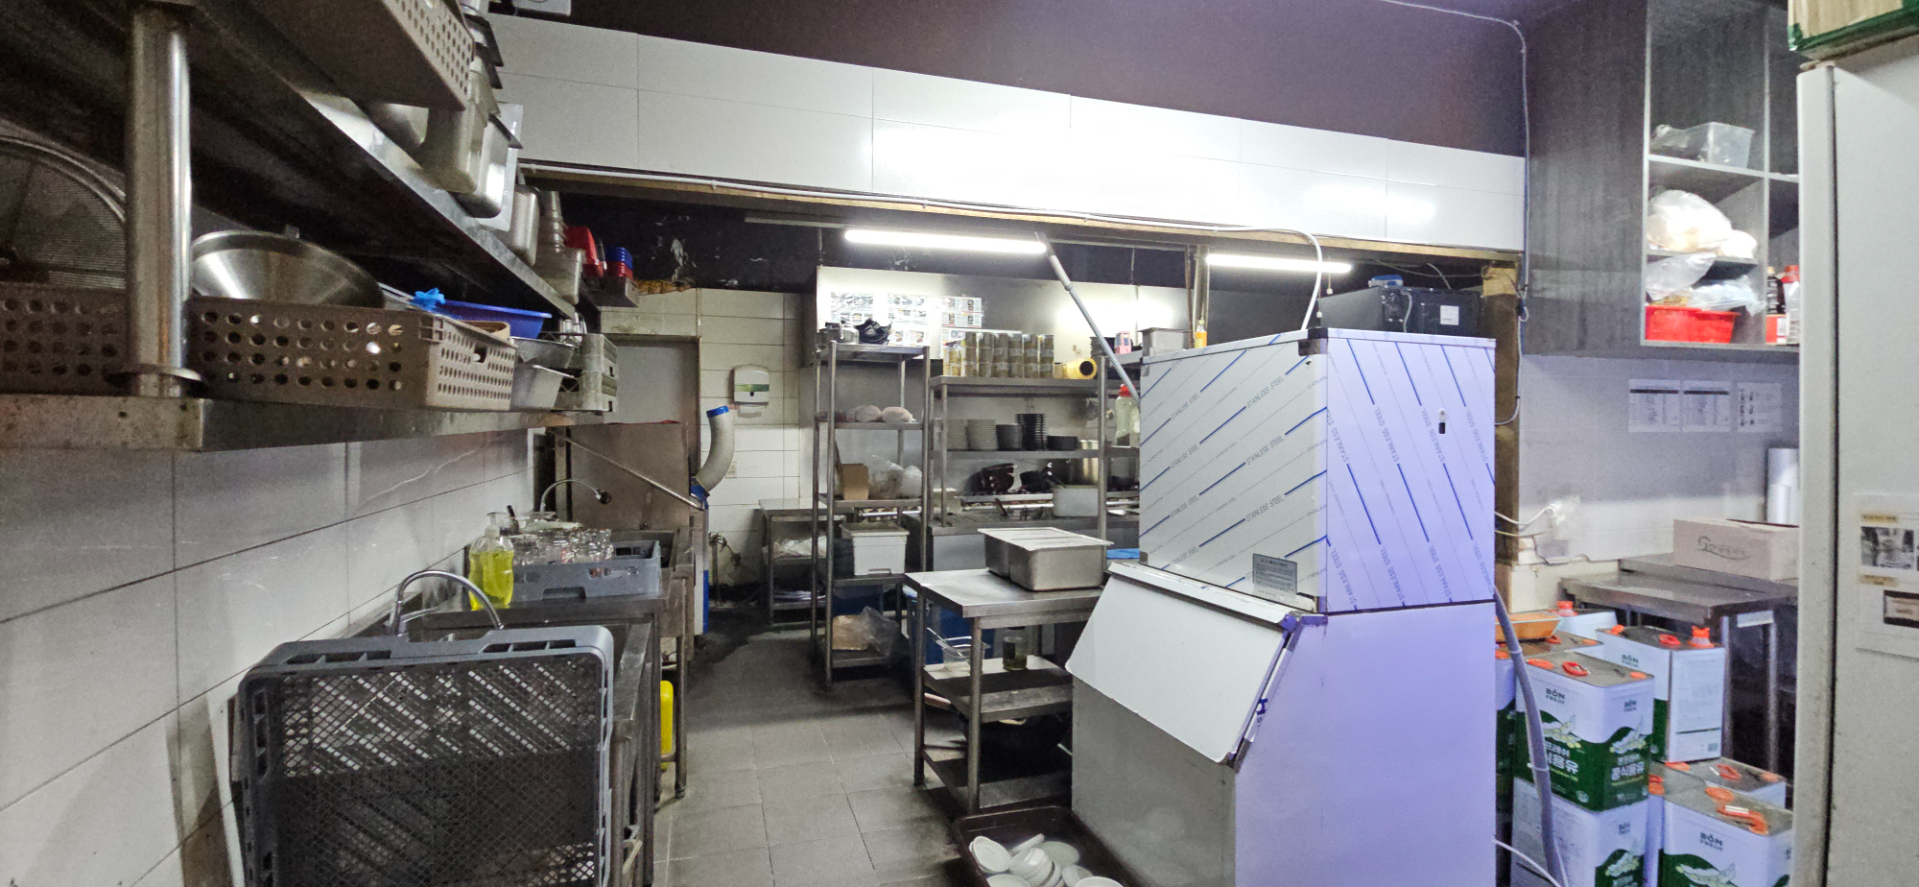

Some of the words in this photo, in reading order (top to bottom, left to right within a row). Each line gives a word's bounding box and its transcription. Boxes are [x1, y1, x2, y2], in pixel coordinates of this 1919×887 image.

[1247, 386, 1269, 409] STAINLESS
[1270, 375, 1284, 390] STEEL
[1374, 406, 1385, 427] STEEL
[1246, 444, 1269, 465] STAINLESS
[1270, 435, 1284, 449] STEEL
[1382, 428, 1400, 463] STAINLESS
[1246, 503, 1269, 522] STAINLESS
[1269, 494, 1284, 508] STEEL
[1331, 548, 1342, 569] STEEL
[1380, 546, 1391, 566] STEEL
[1339, 569, 1357, 605] STAINLESS
[1388, 567, 1405, 601] STAINLESS
